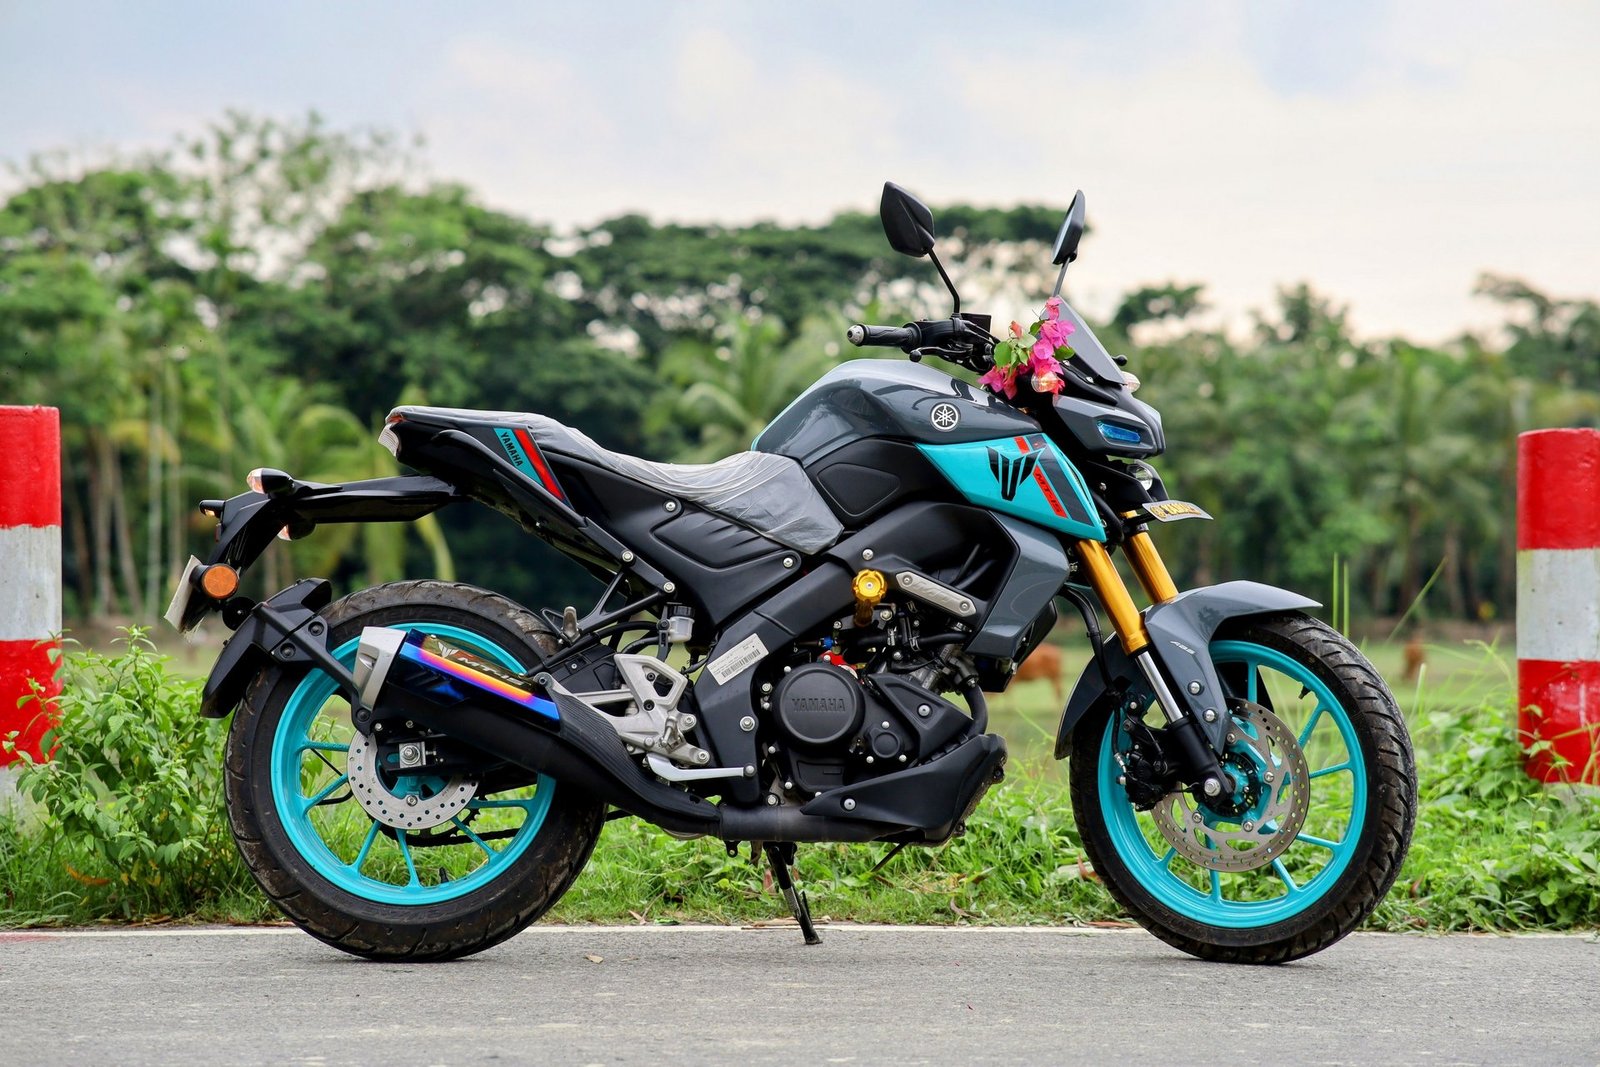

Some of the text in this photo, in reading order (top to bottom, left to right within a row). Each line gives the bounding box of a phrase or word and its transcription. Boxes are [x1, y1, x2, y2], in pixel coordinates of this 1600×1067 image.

[501, 431, 524, 467] YAMAHA
[457, 657, 526, 686] MT-15
[792, 698, 846, 712] YAMAHA
